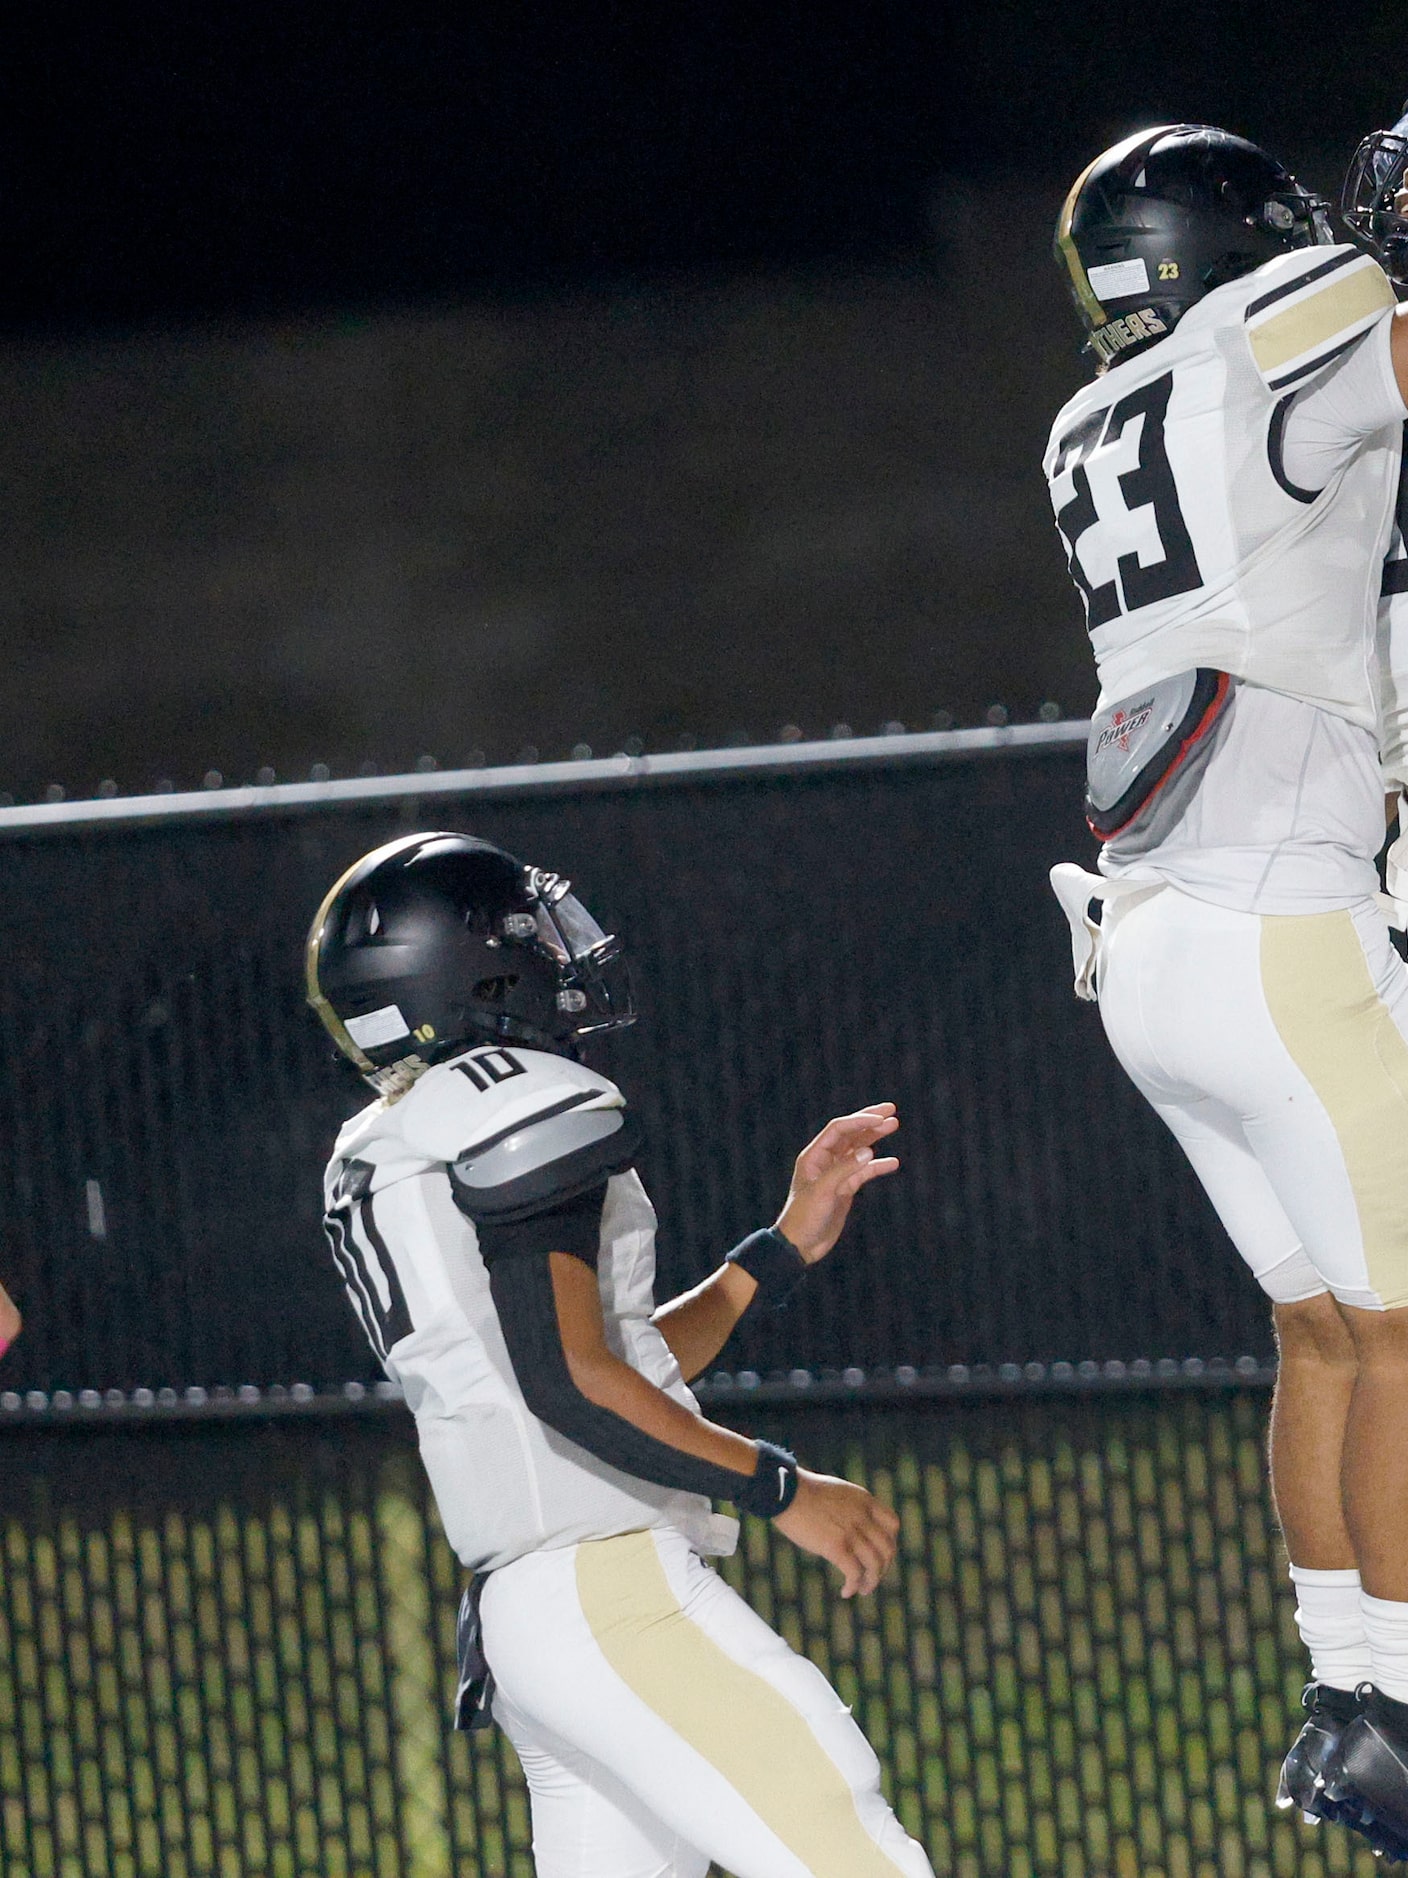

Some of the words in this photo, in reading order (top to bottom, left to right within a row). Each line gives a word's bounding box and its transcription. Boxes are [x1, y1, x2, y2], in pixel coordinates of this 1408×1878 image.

[1157, 262, 1180, 281] 23
[1052, 369, 1205, 632] 23
[412, 1023, 436, 1044] 10
[449, 1048, 529, 1094] 10
